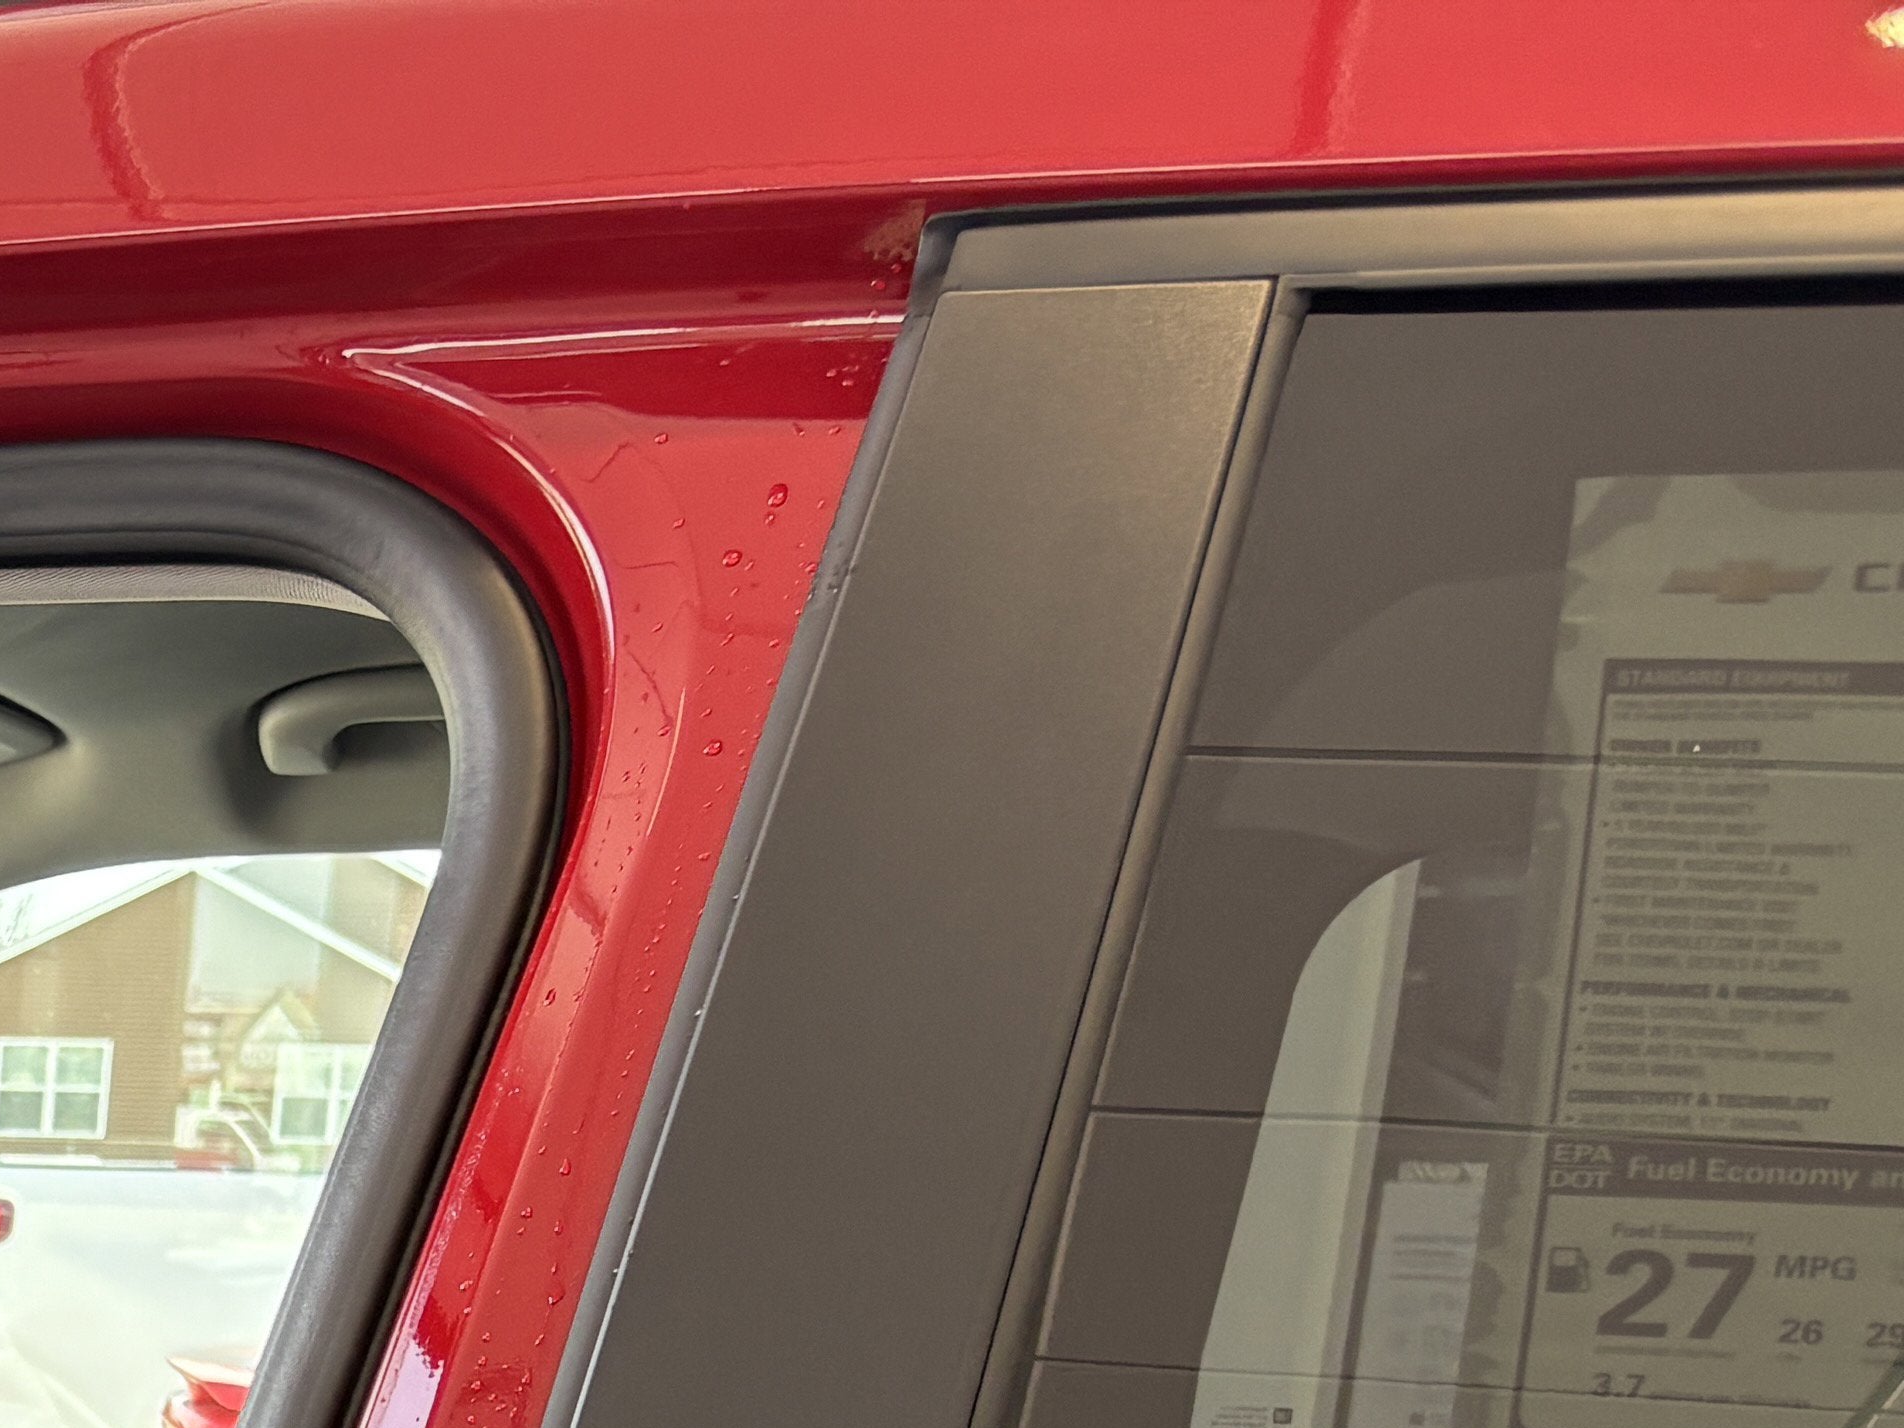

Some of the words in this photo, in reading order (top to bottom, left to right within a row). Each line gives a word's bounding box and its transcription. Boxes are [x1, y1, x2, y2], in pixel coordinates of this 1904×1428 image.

[1552, 1143, 1613, 1164] EPA
[1548, 1169, 1611, 1189] DOT
[1626, 1156, 1697, 1182] Fuel
[1704, 1158, 1861, 1191] Economy
[1595, 1249, 1756, 1340] 27
[1773, 1254, 1859, 1281] MPG
[1778, 1318, 1825, 1345] 26
